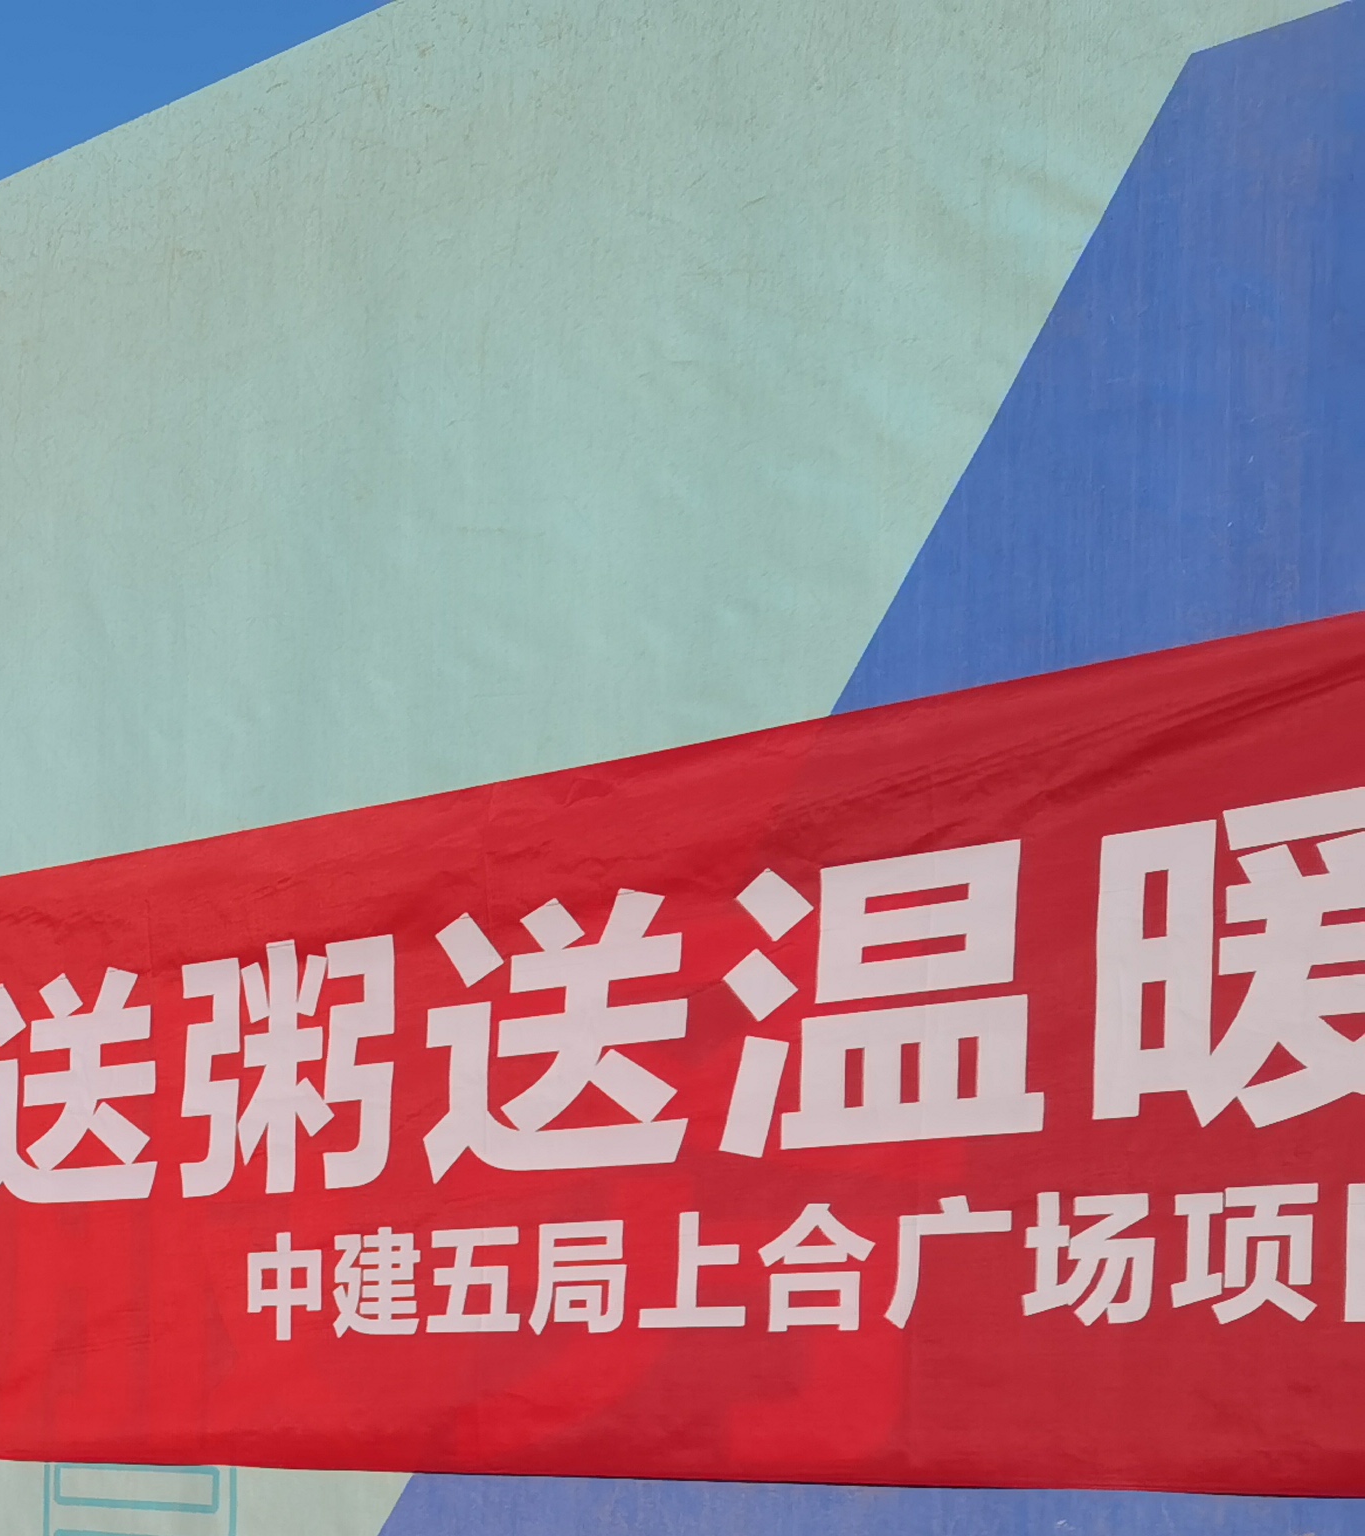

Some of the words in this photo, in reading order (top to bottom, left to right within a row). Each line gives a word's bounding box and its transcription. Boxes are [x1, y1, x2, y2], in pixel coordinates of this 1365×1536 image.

[246, 1182, 1365, 1342] 中建五局上合广场项
